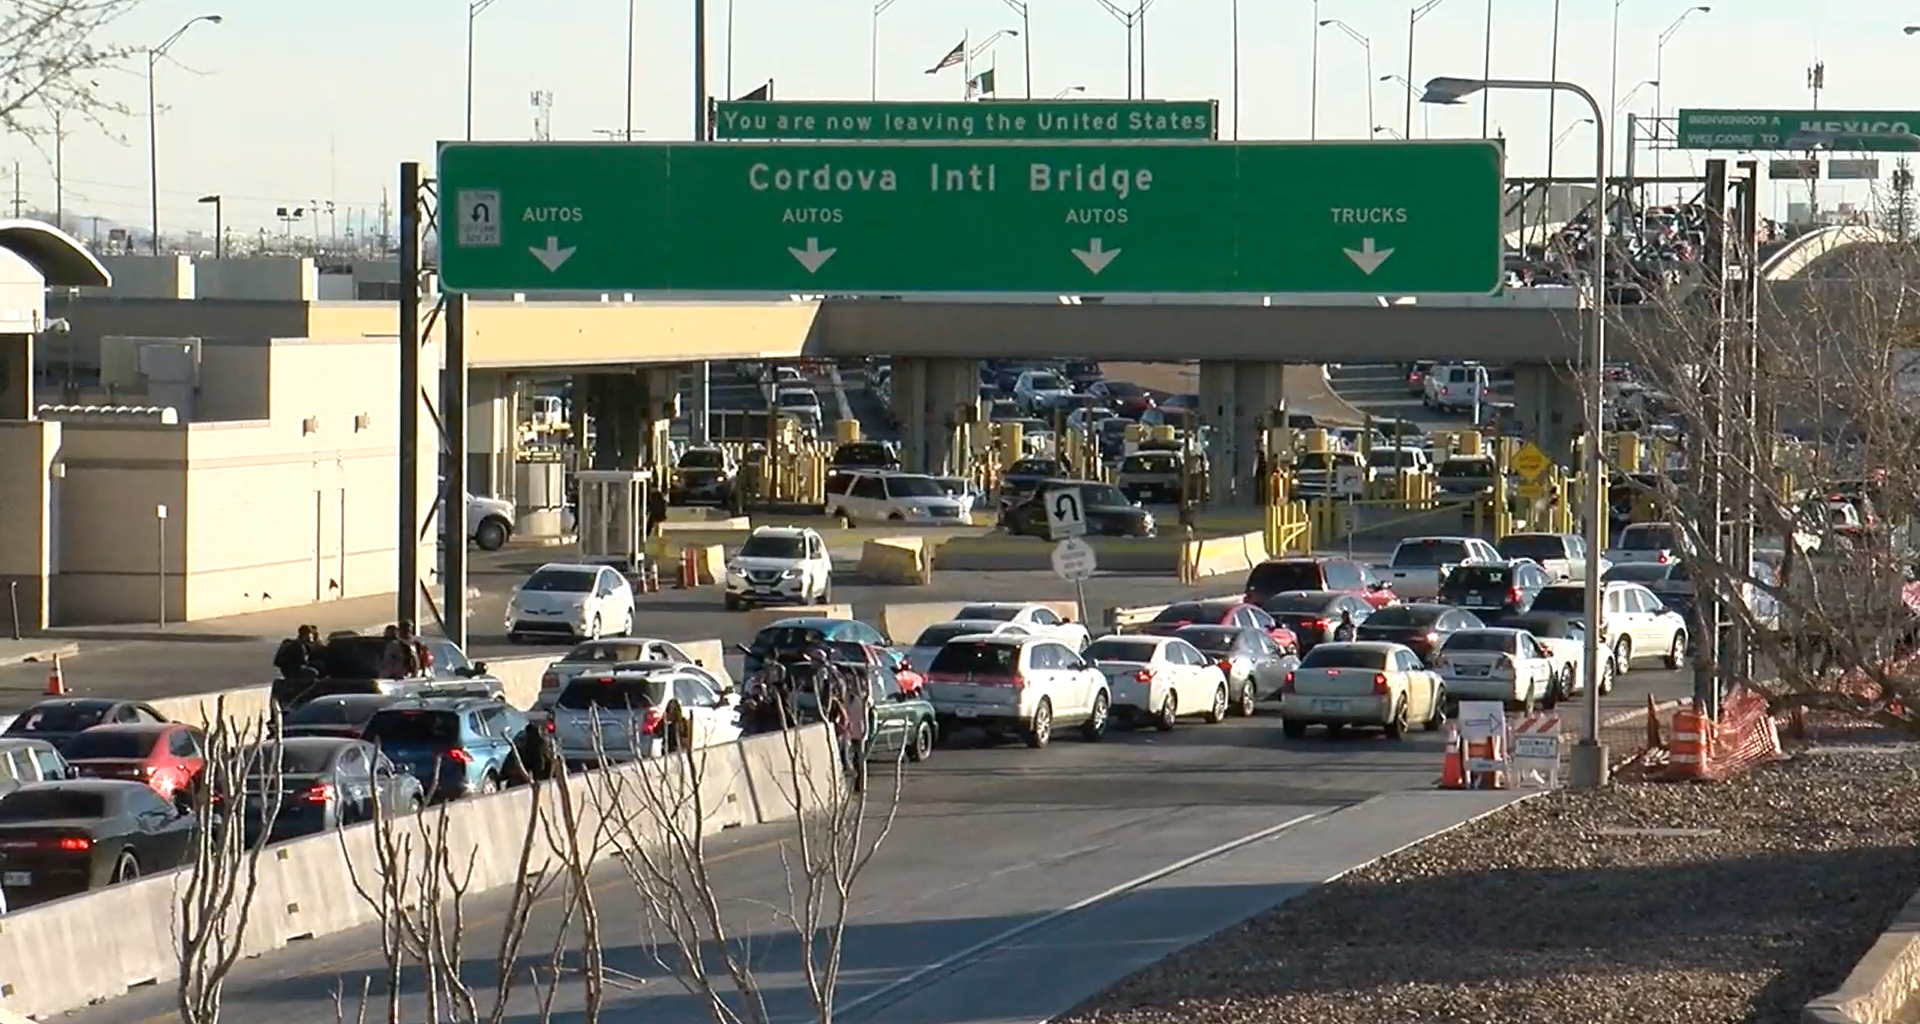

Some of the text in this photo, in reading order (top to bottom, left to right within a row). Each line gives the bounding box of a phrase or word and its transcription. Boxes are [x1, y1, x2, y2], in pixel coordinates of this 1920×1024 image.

[724, 111, 1207, 136] You are now leaving the United States
[1771, 116, 1781, 125] A
[1760, 134, 1779, 143] TO
[750, 163, 1154, 200] Cordova Intl Bridge
[522, 207, 583, 222] AUTOS
[782, 208, 843, 223] AUTOS
[1065, 208, 1129, 223] AUTOS
[1330, 208, 1407, 223] TRUCKS
